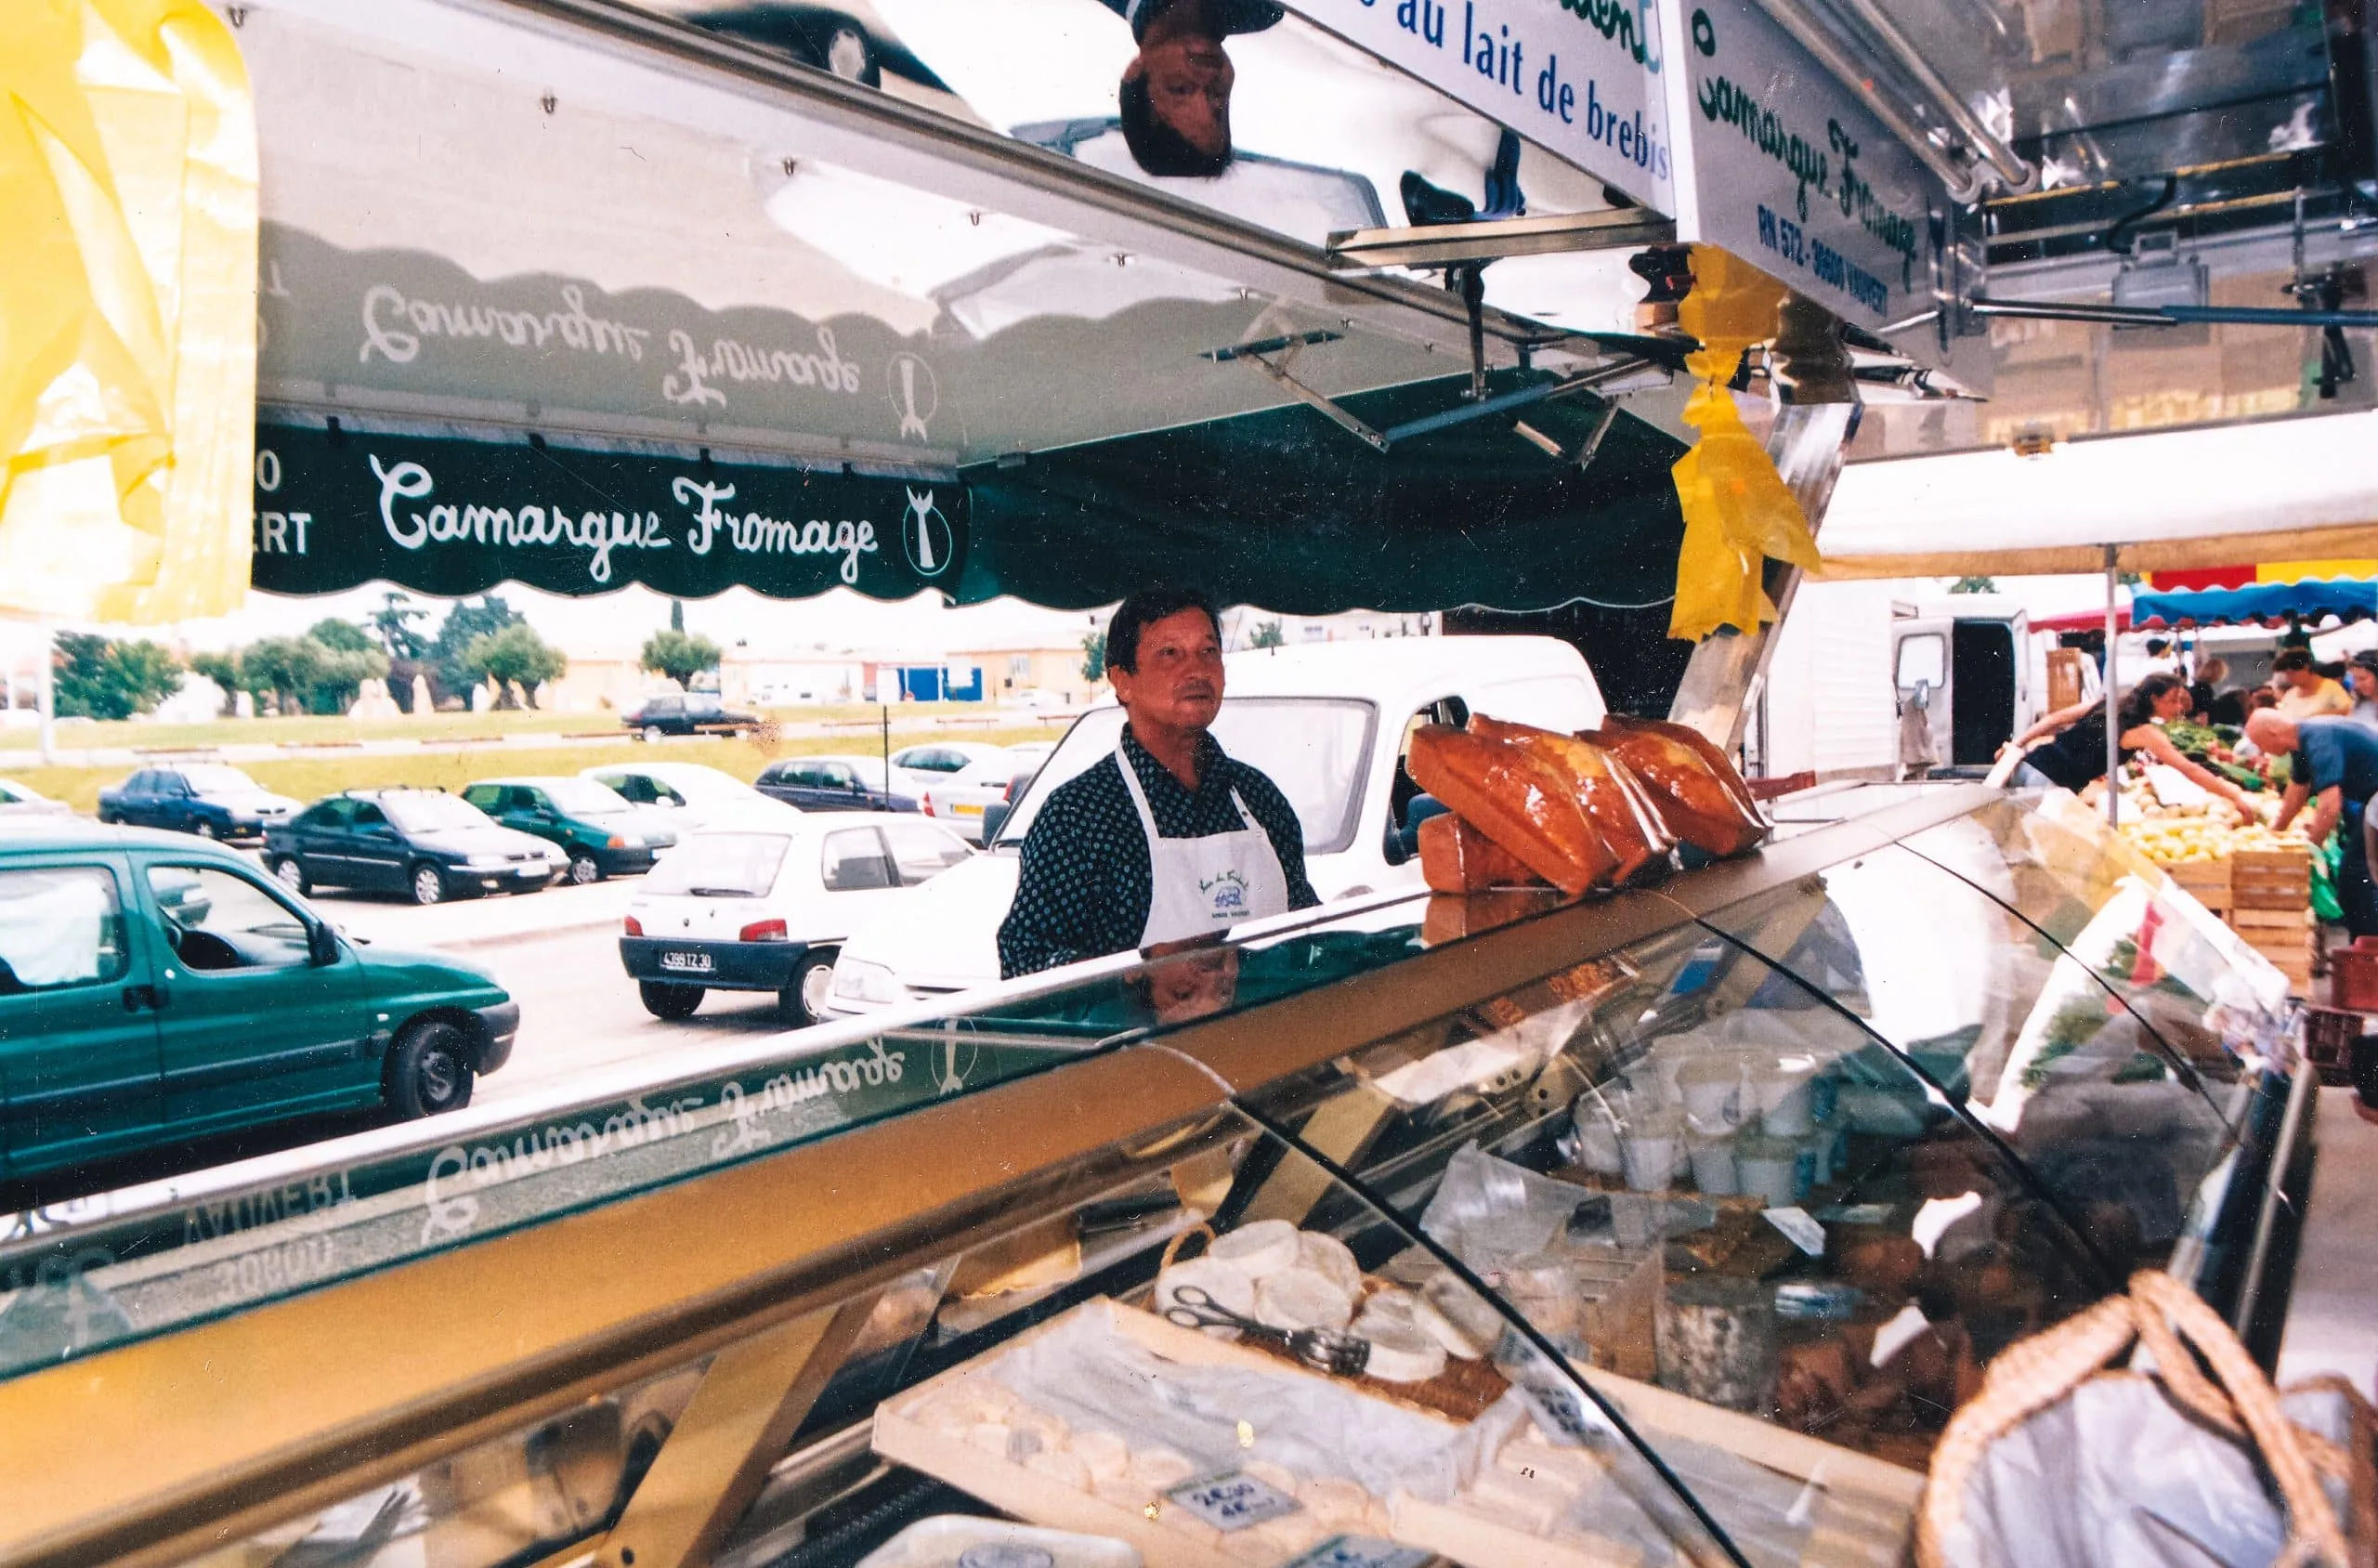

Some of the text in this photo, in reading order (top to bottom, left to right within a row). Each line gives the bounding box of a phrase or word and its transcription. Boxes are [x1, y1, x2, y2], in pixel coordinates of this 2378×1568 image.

[1397, 0, 1669, 181] au lait de brebis
[1780, 216, 1804, 267] 572
[369, 452, 879, 584] Camargue Fromage
